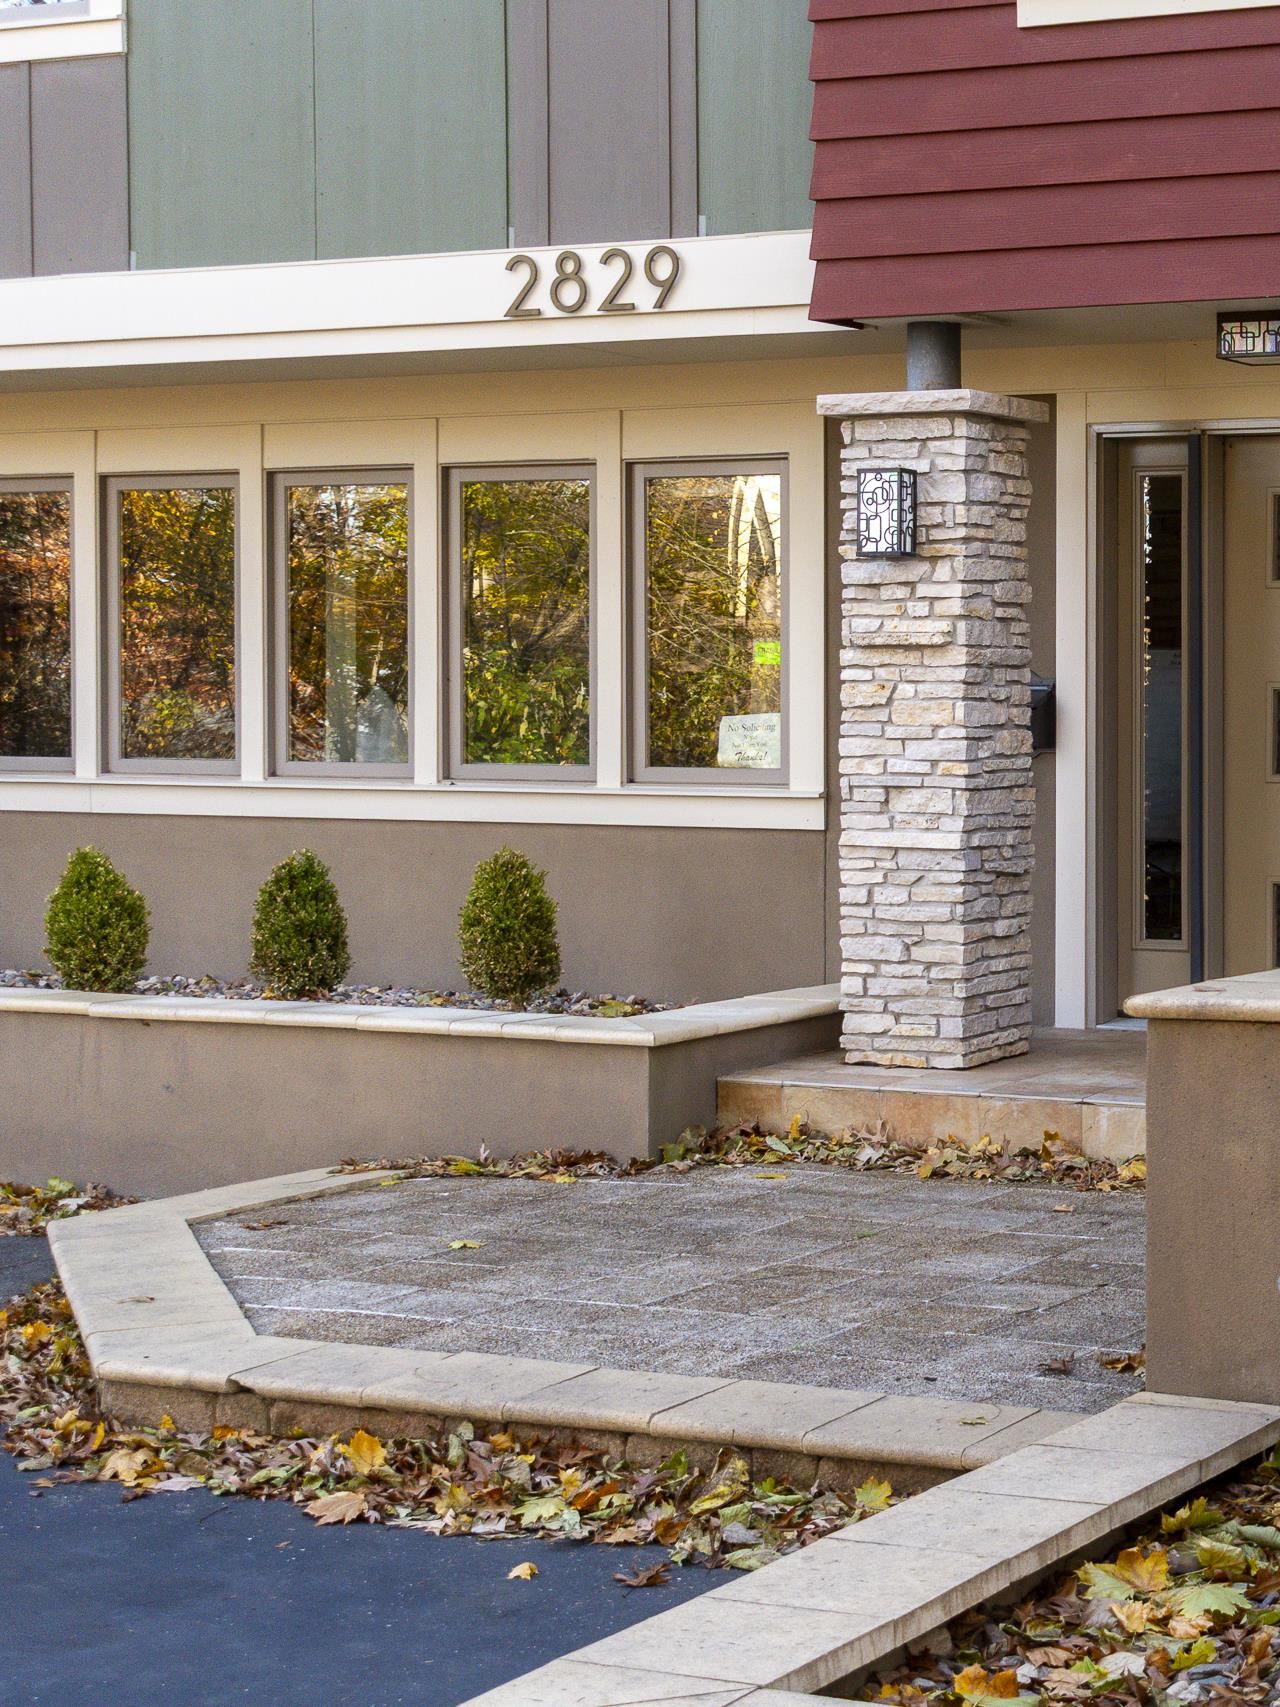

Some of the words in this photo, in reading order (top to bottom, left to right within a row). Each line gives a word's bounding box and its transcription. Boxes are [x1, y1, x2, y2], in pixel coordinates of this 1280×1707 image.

[503, 245, 680, 318] 2829
[727, 723, 739, 732] No
[741, 722, 776, 733] Solicting
[735, 751, 768, 762] Thanks!
